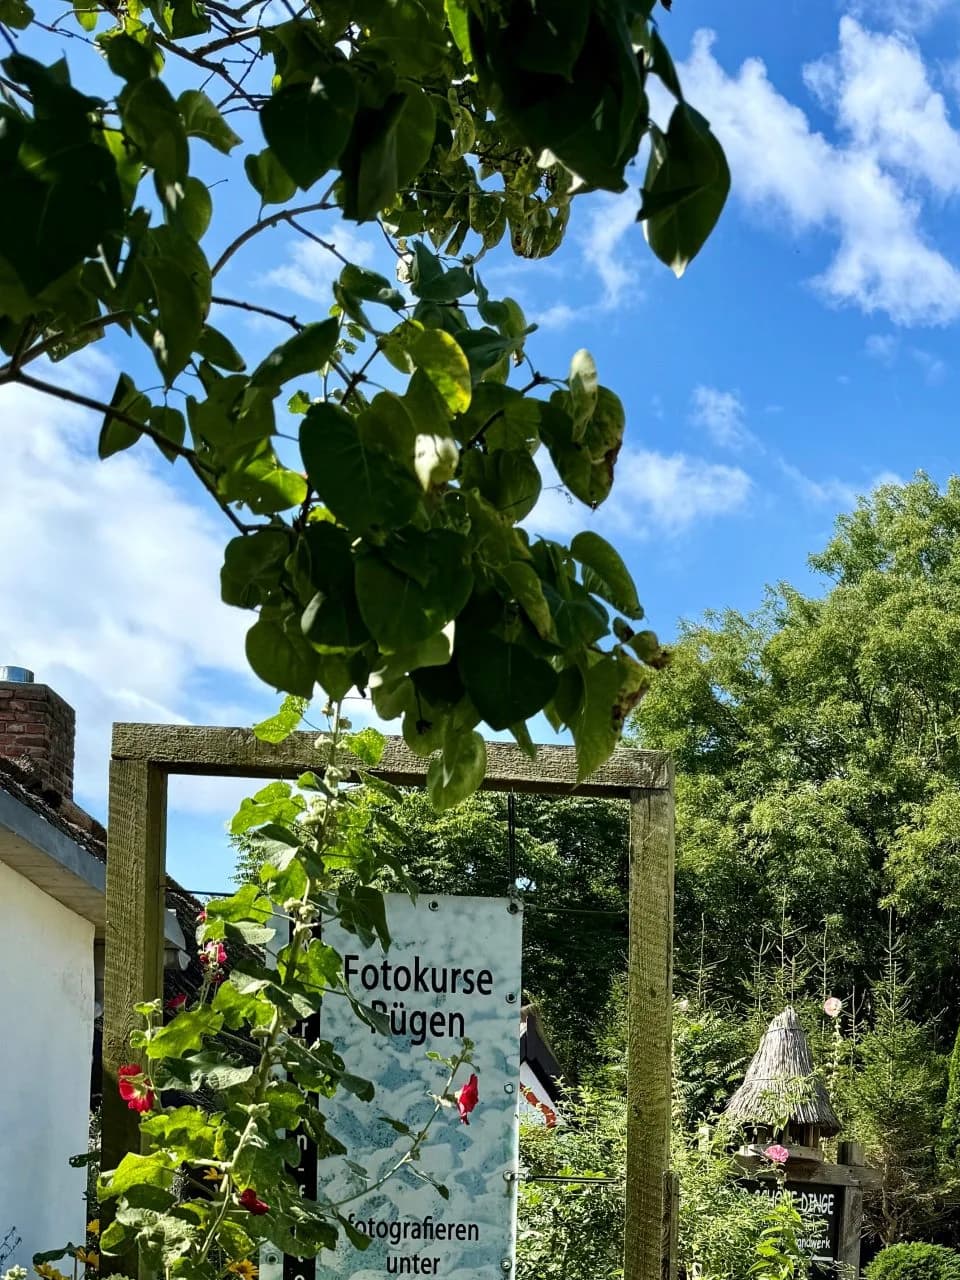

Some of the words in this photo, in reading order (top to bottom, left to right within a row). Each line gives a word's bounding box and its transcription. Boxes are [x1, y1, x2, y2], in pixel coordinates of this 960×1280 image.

[344, 954, 493, 995] Fotokurse
[801, 1192, 834, 1214] DINGE
[386, 1254, 441, 1275] unter
